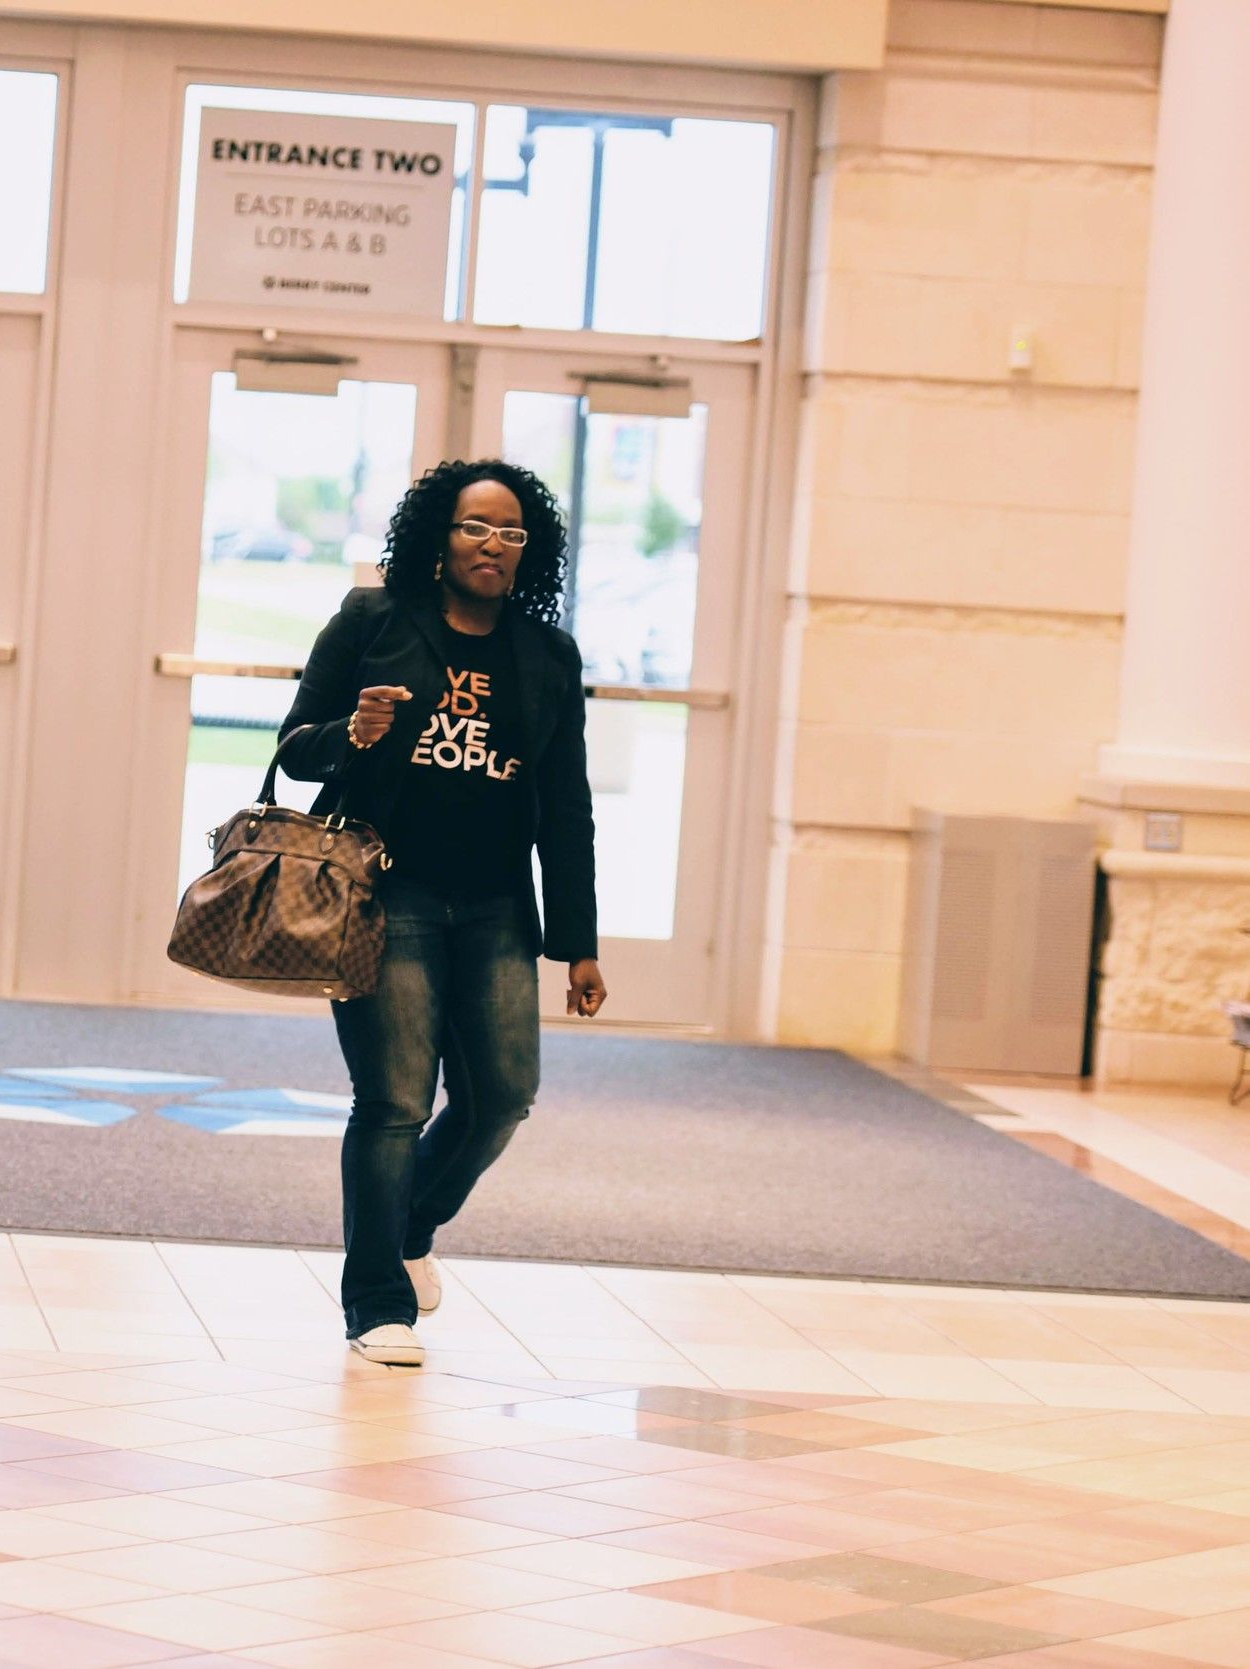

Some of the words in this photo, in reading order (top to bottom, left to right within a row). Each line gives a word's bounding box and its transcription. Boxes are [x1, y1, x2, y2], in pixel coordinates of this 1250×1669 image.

[212, 138, 361, 170] ENTRANCE
[374, 149, 442, 176] TWO
[234, 192, 296, 217] EAST
[302, 198, 411, 227] PARKING
[254, 225, 313, 250] LOTS
[320, 231, 339, 252] A
[347, 231, 363, 254] &
[369, 233, 387, 256] B
[446, 666, 492, 697] VE
[436, 690, 487, 719] D.
[421, 712, 491, 748] VE
